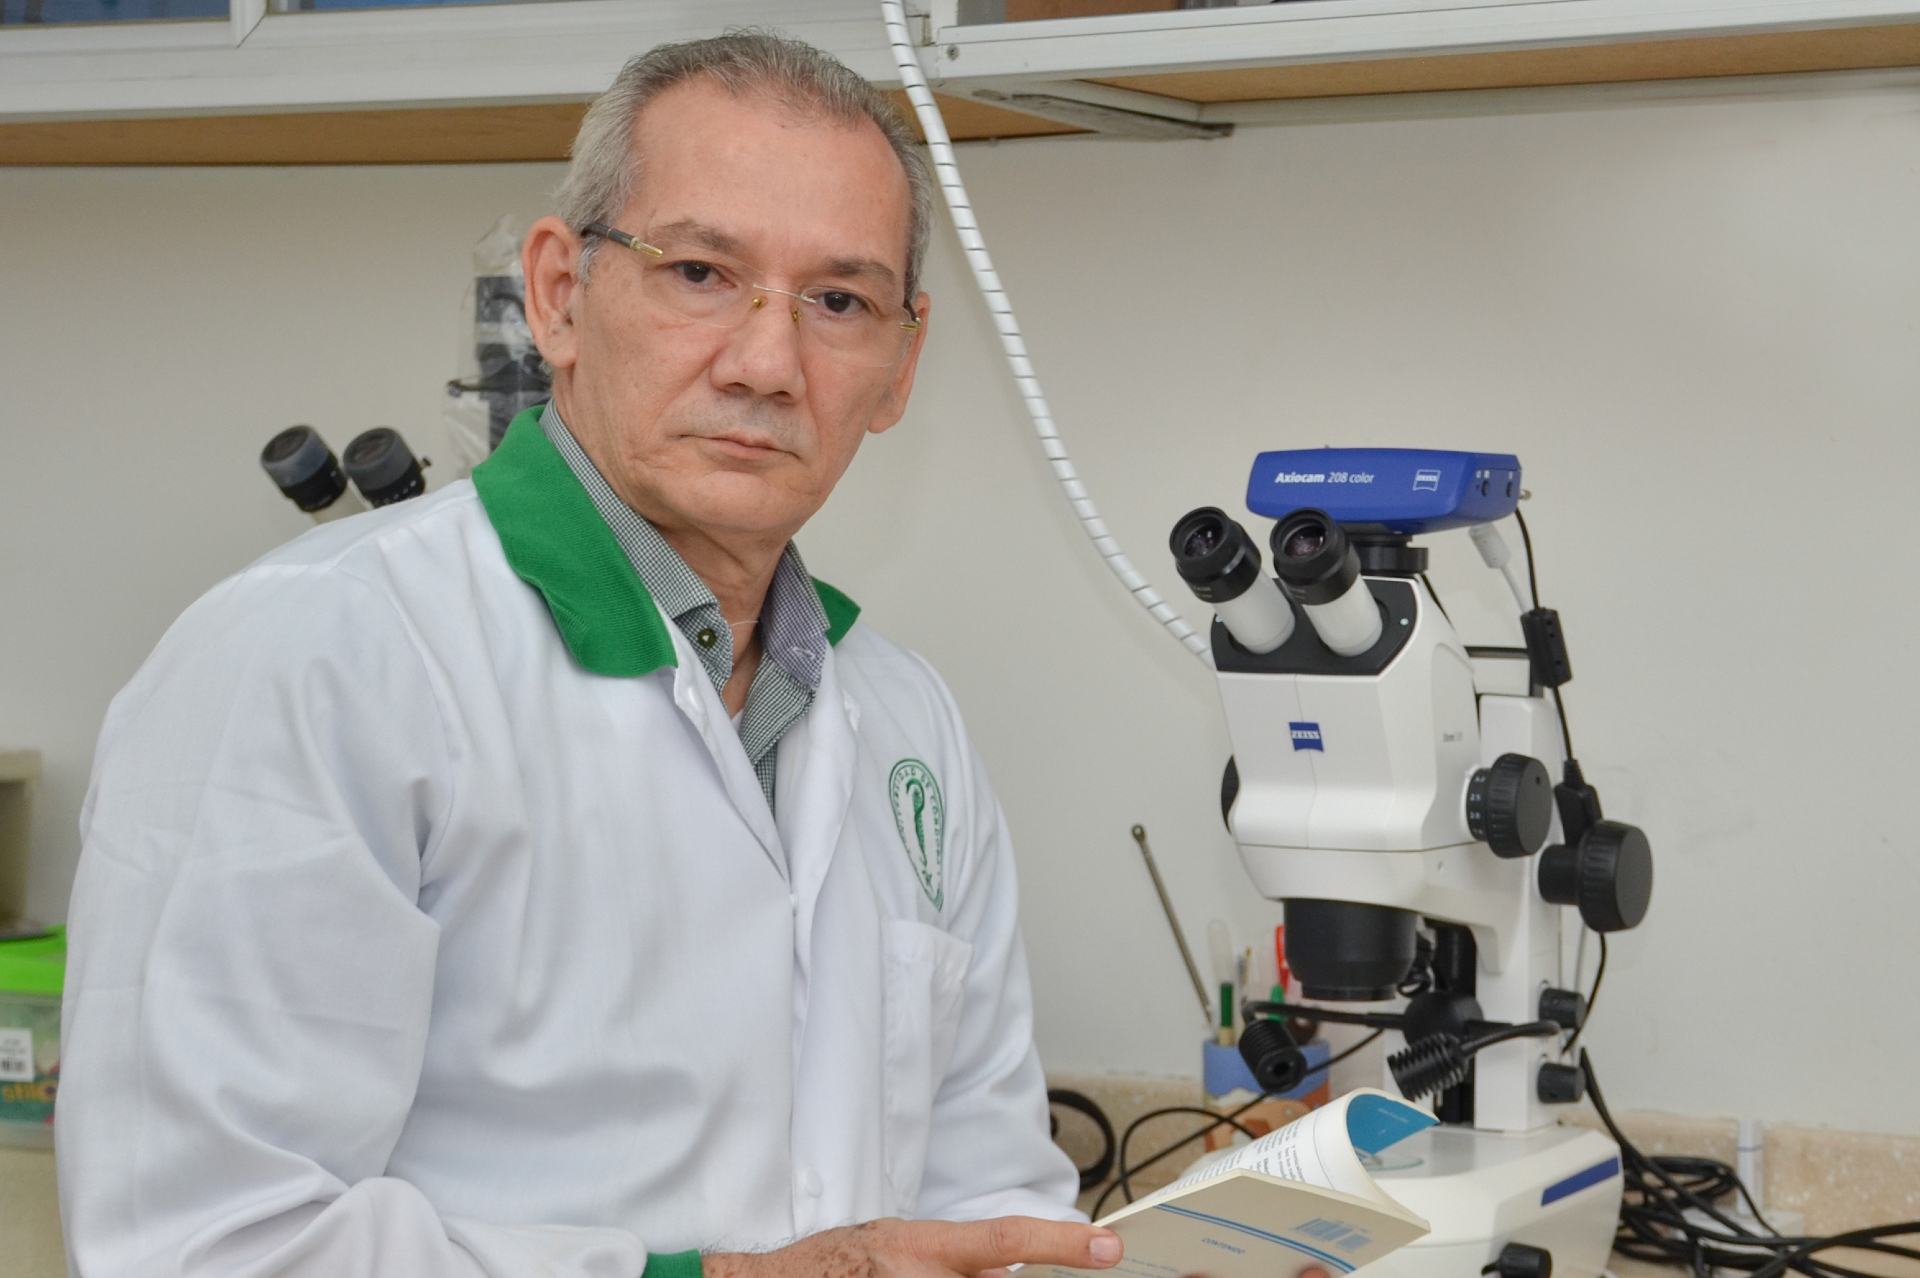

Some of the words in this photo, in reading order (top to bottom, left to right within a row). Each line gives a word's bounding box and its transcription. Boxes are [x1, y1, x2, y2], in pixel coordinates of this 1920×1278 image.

[1275, 471, 1325, 484] Axiocam
[1327, 471, 1348, 483] 208
[1349, 472, 1375, 483] color
[1291, 730, 1321, 740] ZEISS
